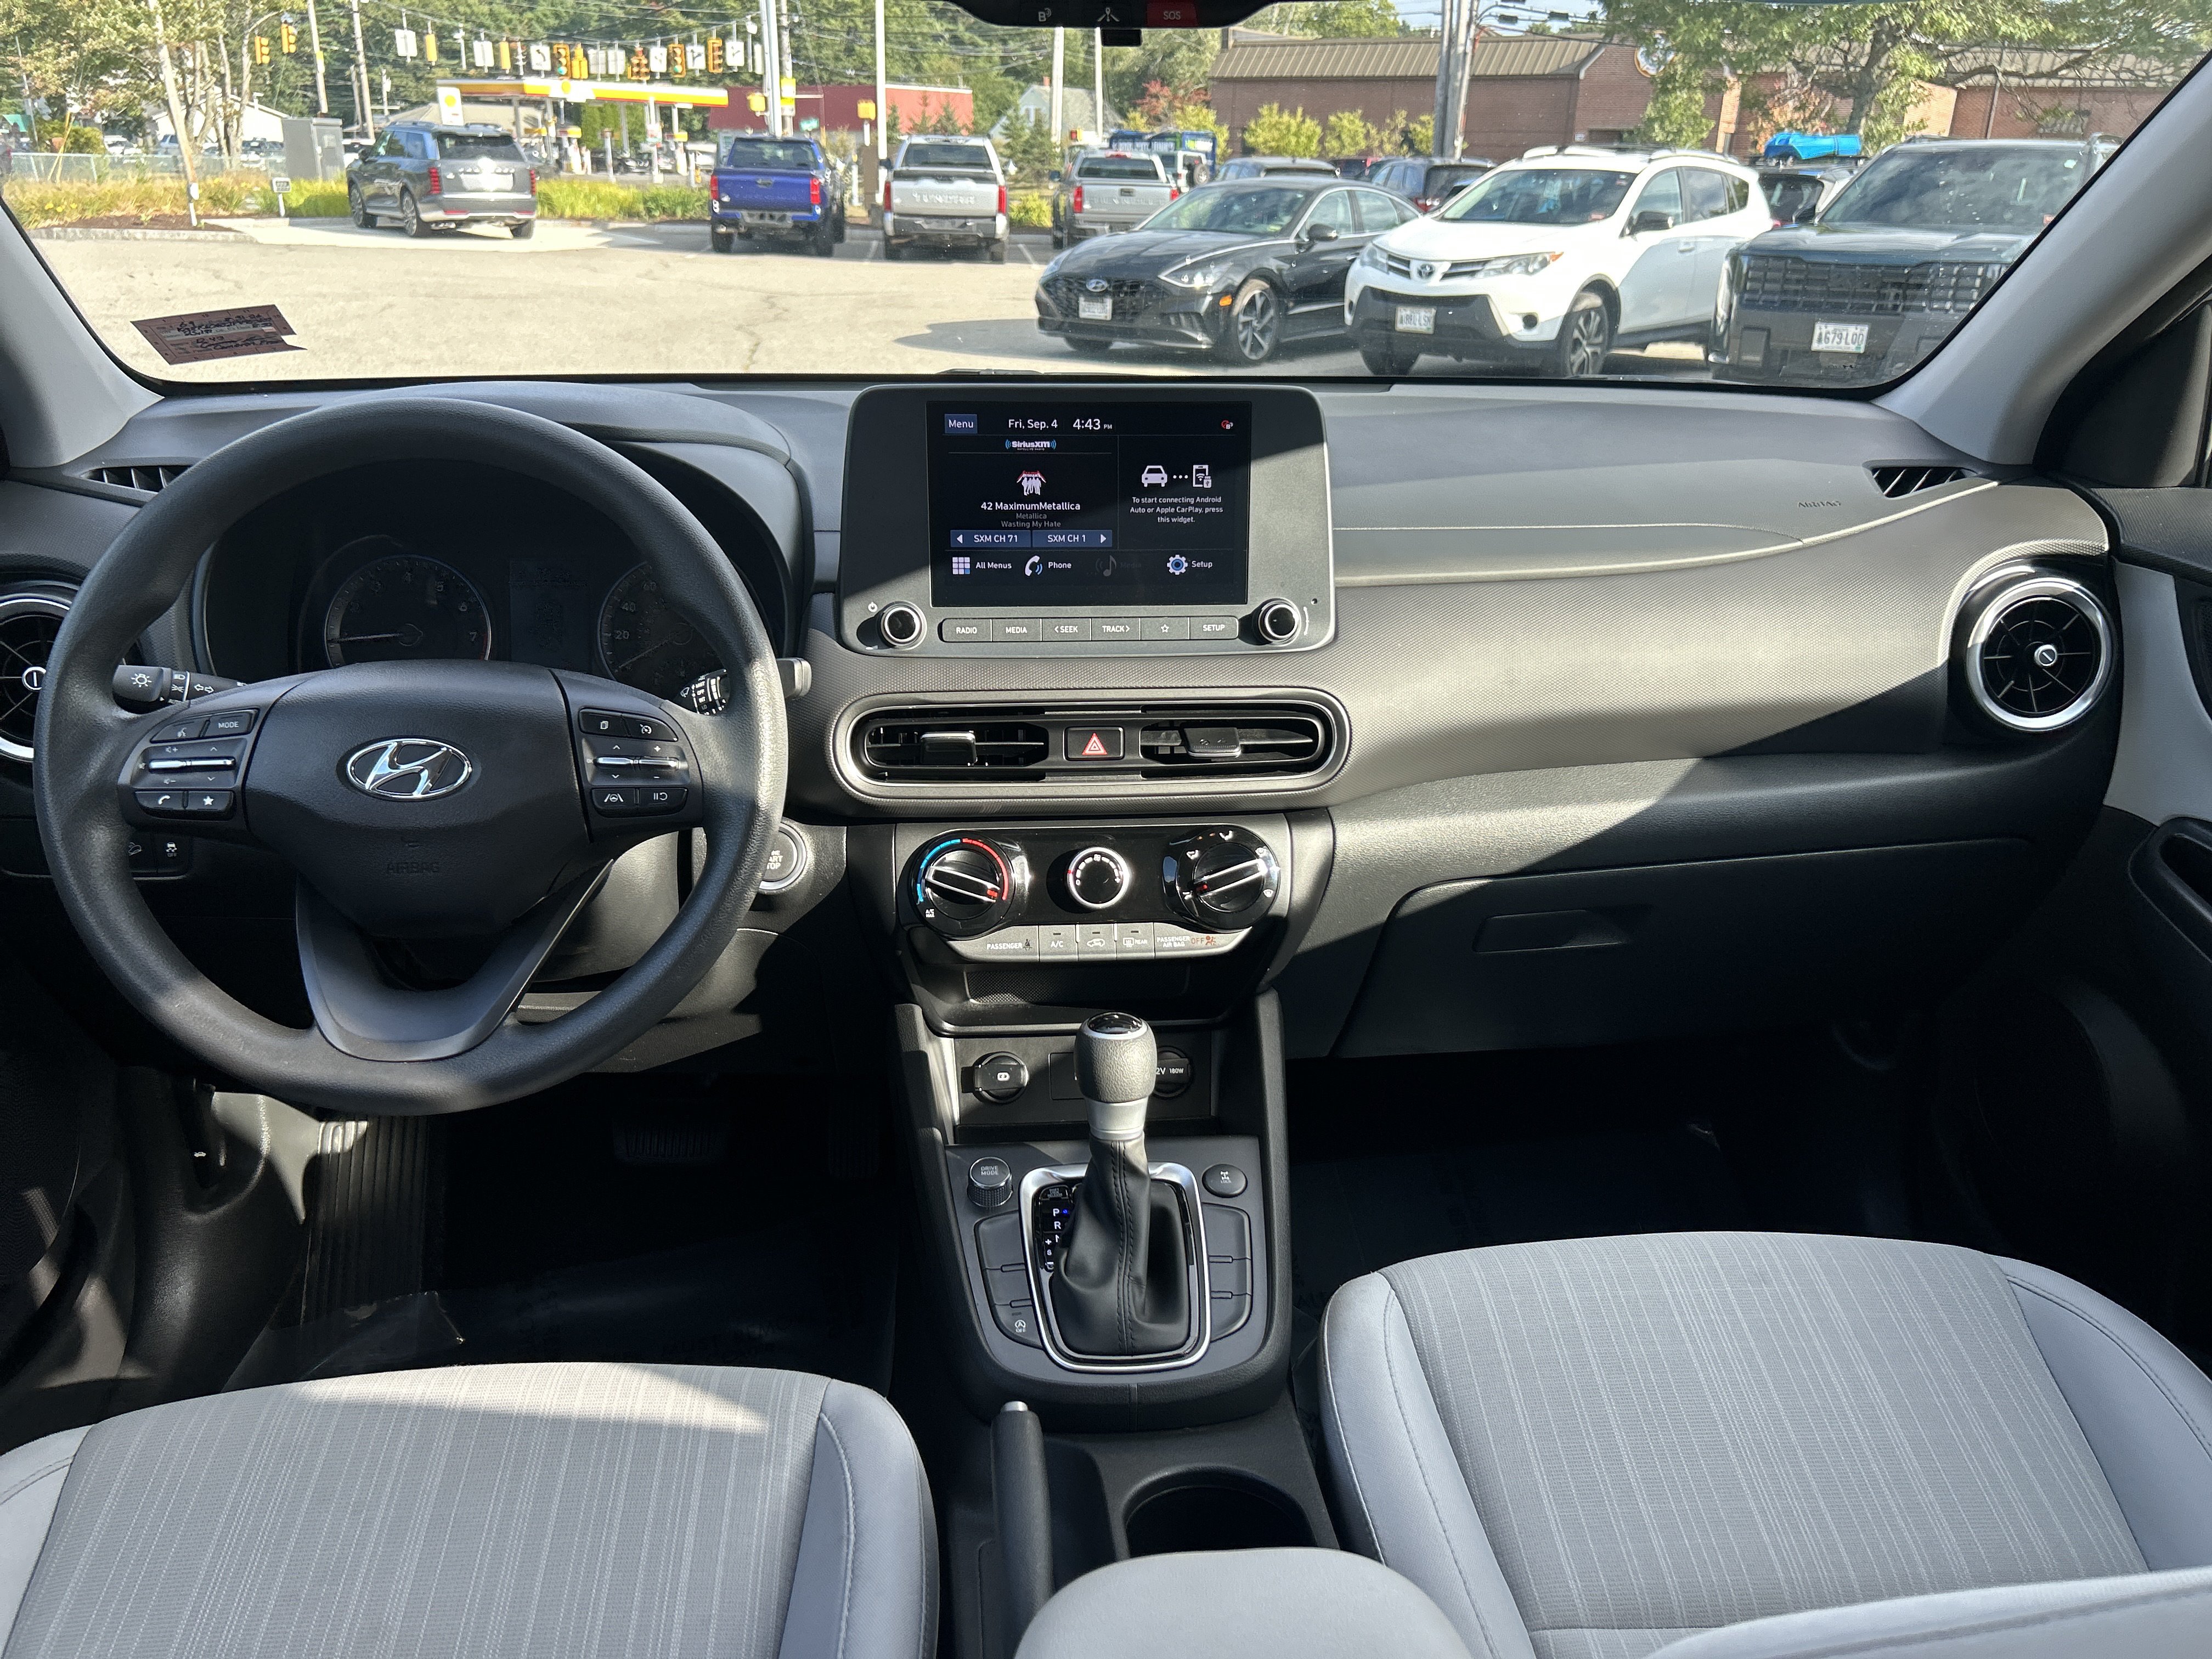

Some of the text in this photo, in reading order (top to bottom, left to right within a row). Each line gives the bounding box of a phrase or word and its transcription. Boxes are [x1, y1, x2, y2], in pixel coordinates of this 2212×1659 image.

[1163, 11, 1181, 20] SOS
[948, 419, 974, 428] Menu
[1008, 419, 1058, 430] Fri, Sep. 4
[1073, 419, 1101, 430] 4:43
[1159, 496, 1194, 504] connecting
[995, 502, 1081, 510] MaximumMetallica
[615, 630, 630, 640] 20
[1053, 1208, 1060, 1217] P
[1054, 1221, 1062, 1229] R
